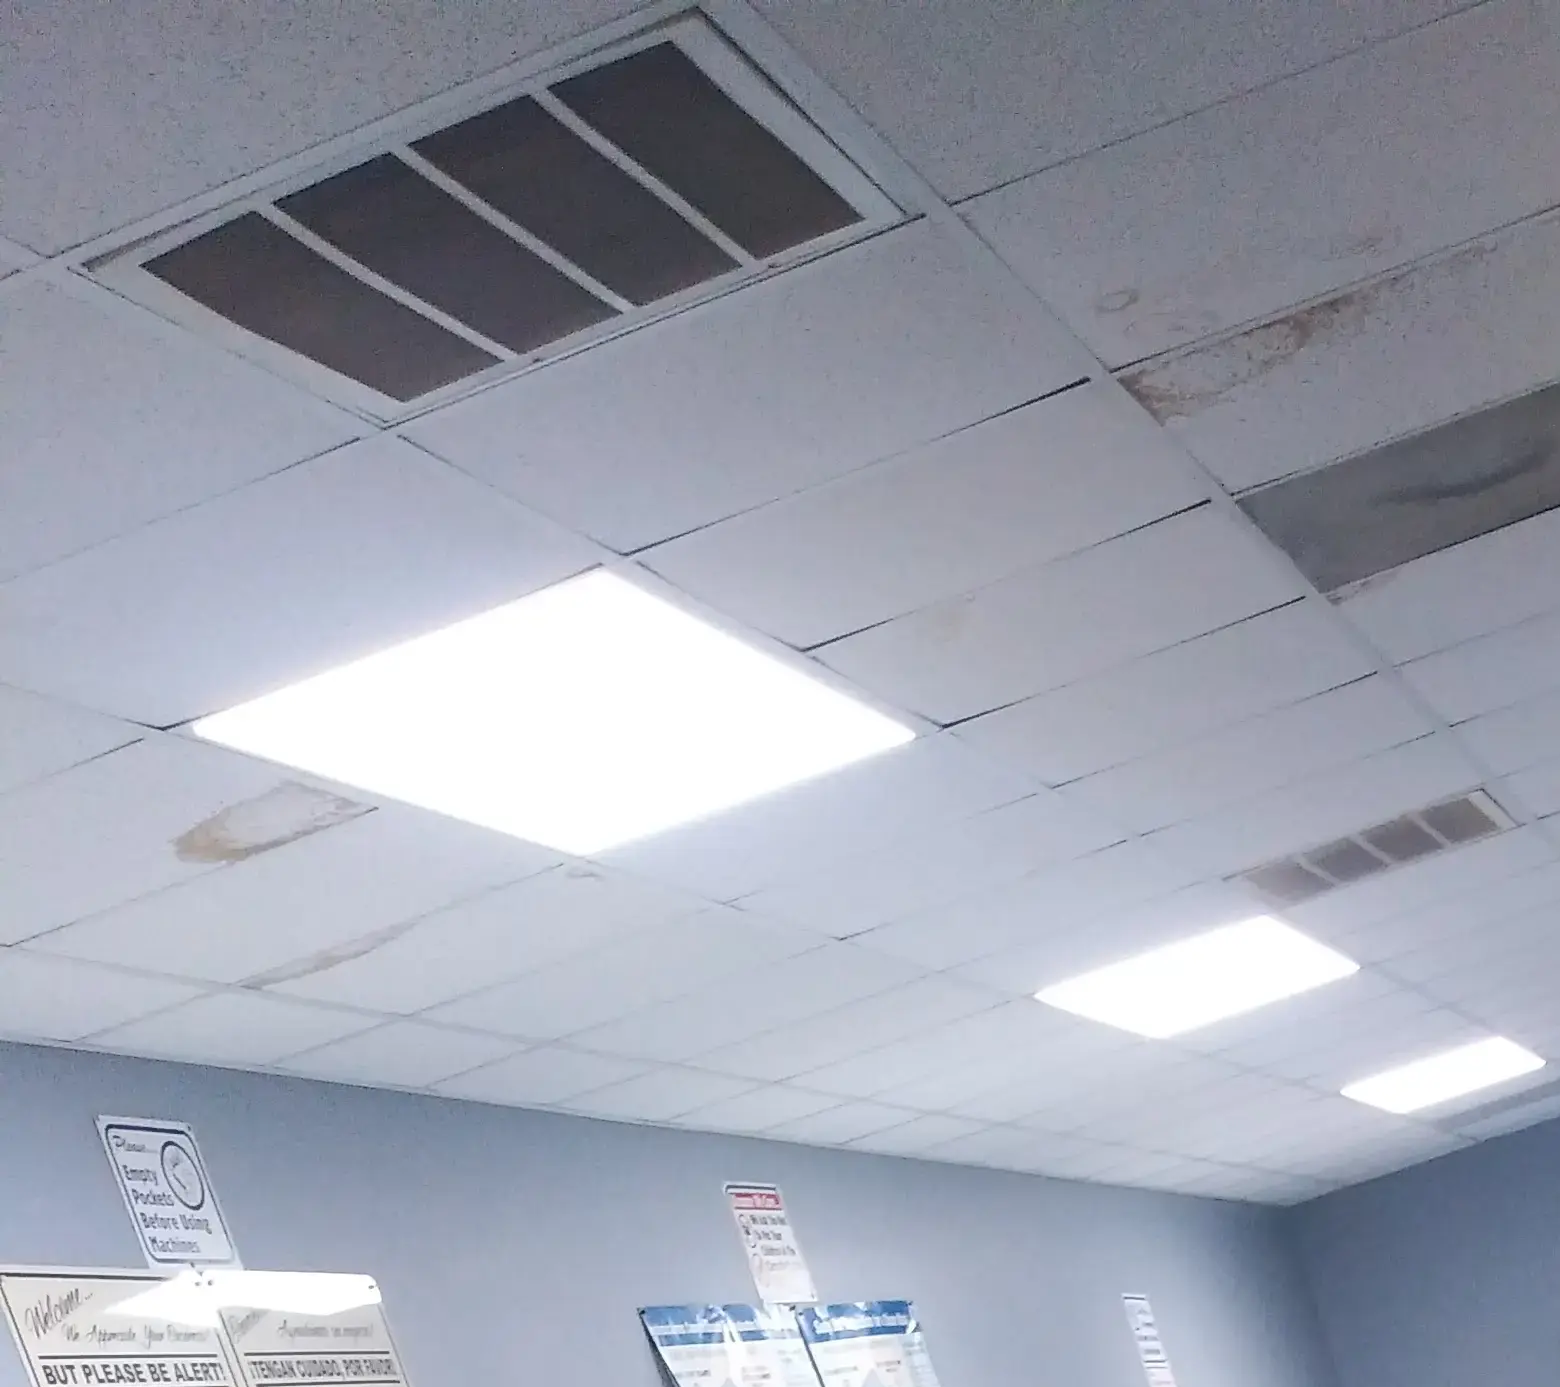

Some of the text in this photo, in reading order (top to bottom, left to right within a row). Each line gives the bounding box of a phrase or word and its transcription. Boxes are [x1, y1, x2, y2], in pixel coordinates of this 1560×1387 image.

[122, 1165, 159, 1186] Empty
[131, 1188, 175, 1207] Pockets
[140, 1212, 212, 1235] Before Using
[41, 1361, 228, 1385] BUT PLEASE BE ALERT!
